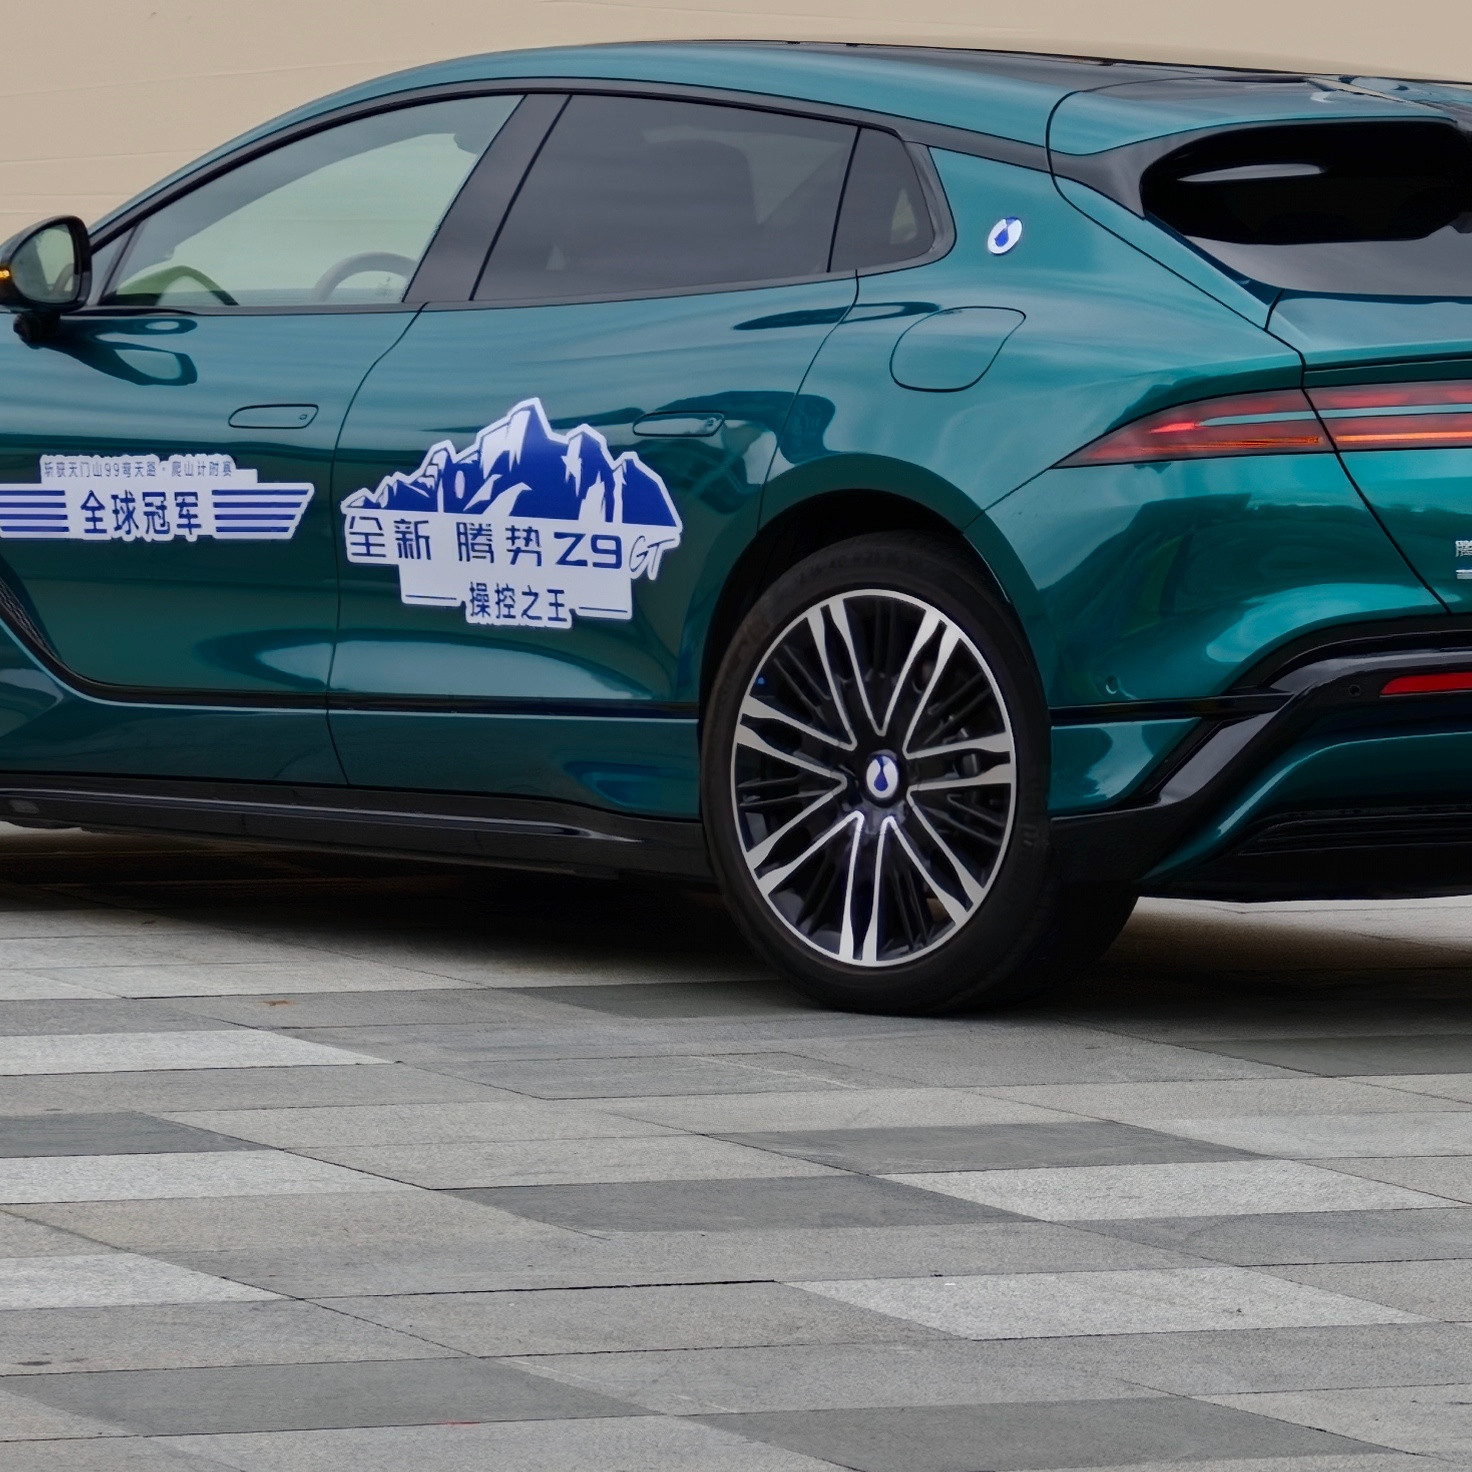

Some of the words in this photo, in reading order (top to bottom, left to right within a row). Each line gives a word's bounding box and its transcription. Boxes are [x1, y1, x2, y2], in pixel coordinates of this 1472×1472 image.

[80, 489, 202, 536] 全球冠军
[468, 581, 568, 623] 操控之王
